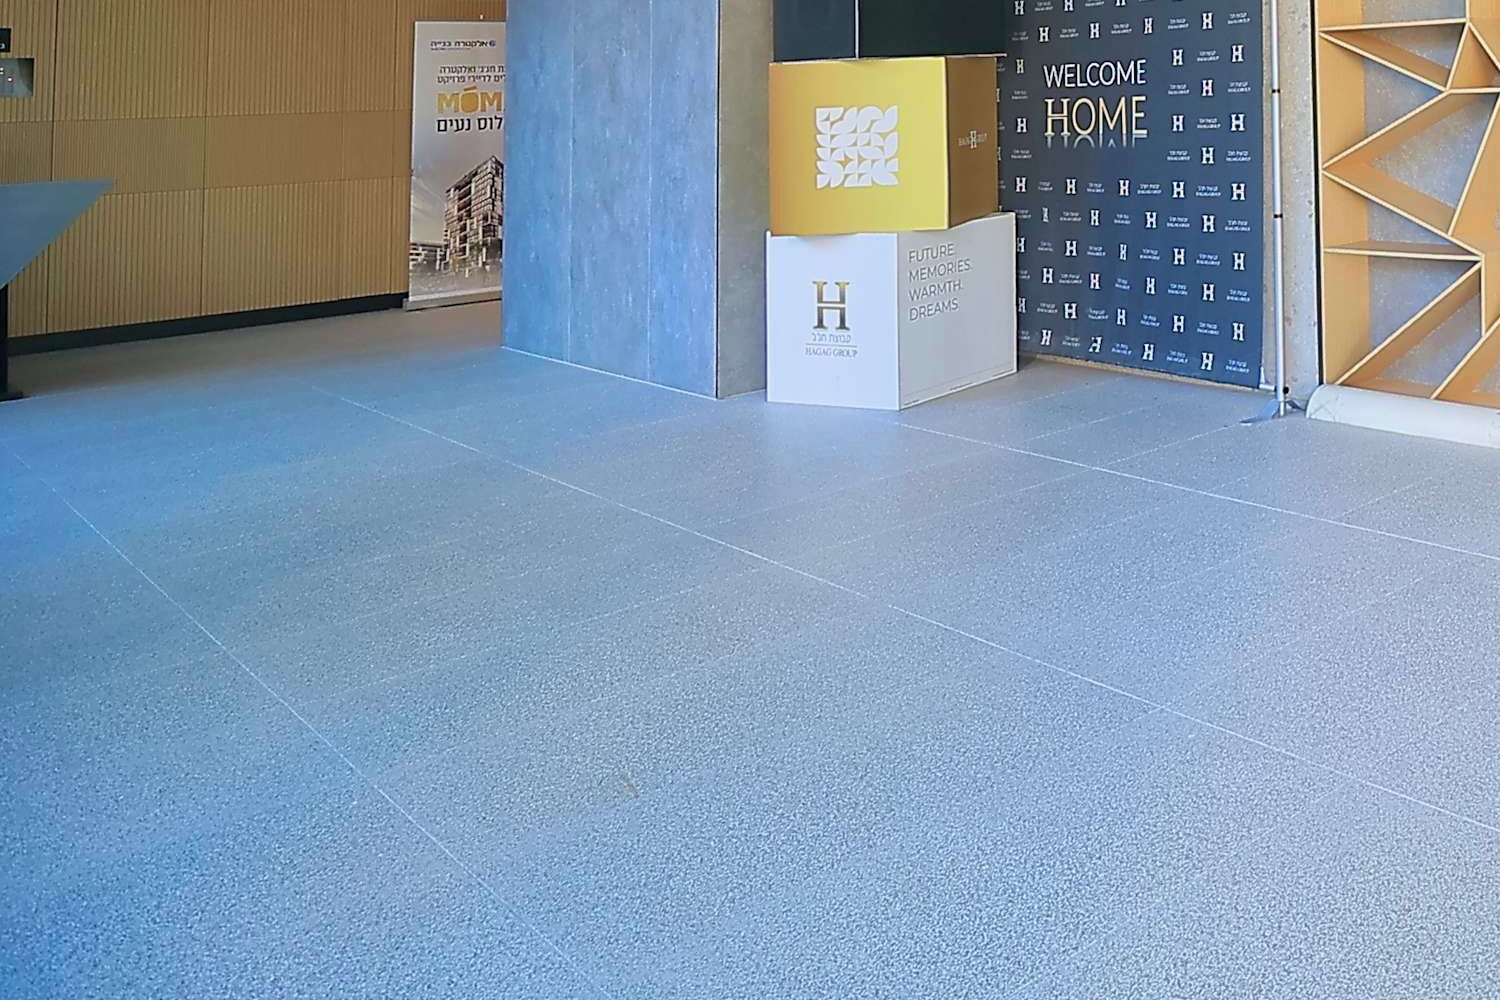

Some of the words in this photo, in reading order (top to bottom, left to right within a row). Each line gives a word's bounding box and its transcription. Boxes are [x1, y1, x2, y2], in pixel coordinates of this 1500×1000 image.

[1014, 1, 1024, 14] H
[1143, 18, 1152, 34] H
[1202, 13, 1212, 29] H
[1038, 27, 1049, 42] H
[1089, 23, 1099, 38] H
[1172, 50, 1183, 65] H
[1231, 45, 1243, 62] H
[1043, 59, 1147, 88] WELCOME
[1202, 80, 1213, 96] H
[437, 85, 505, 113] MÓM
[1044, 96, 1148, 136] HOME
[1172, 116, 1183, 131] H
[1230, 114, 1244, 131] H
[437, 118, 471, 132] נעים
[1016, 118, 1026, 132] H
[1201, 148, 1214, 163] H
[1015, 178, 1026, 192] H
[1066, 179, 1076, 194] H
[1119, 180, 1129, 196] H
[1172, 182, 1184, 197] H
[1231, 184, 1245, 200] H
[1090, 210, 1099, 225] H
[1145, 212, 1156, 228] H
[1202, 215, 1214, 232] H
[909, 243, 955, 263] FUTURE
[1064, 241, 1076, 256] H
[1173, 248, 1184, 265] H
[1233, 253, 1244, 270] H
[1042, 268, 1053, 283] H
[1089, 274, 1099, 289] H
[1145, 278, 1155, 294] H
[1202, 284, 1214, 301] H
[812, 280, 850, 331] H
[1064, 303, 1076, 318] H
[1116, 309, 1125, 325] H
[1172, 316, 1184, 332] H
[1040, 330, 1051, 345] H
[1232, 323, 1243, 341] H
[1142, 344, 1153, 360] H
[1200, 353, 1213, 370] H
